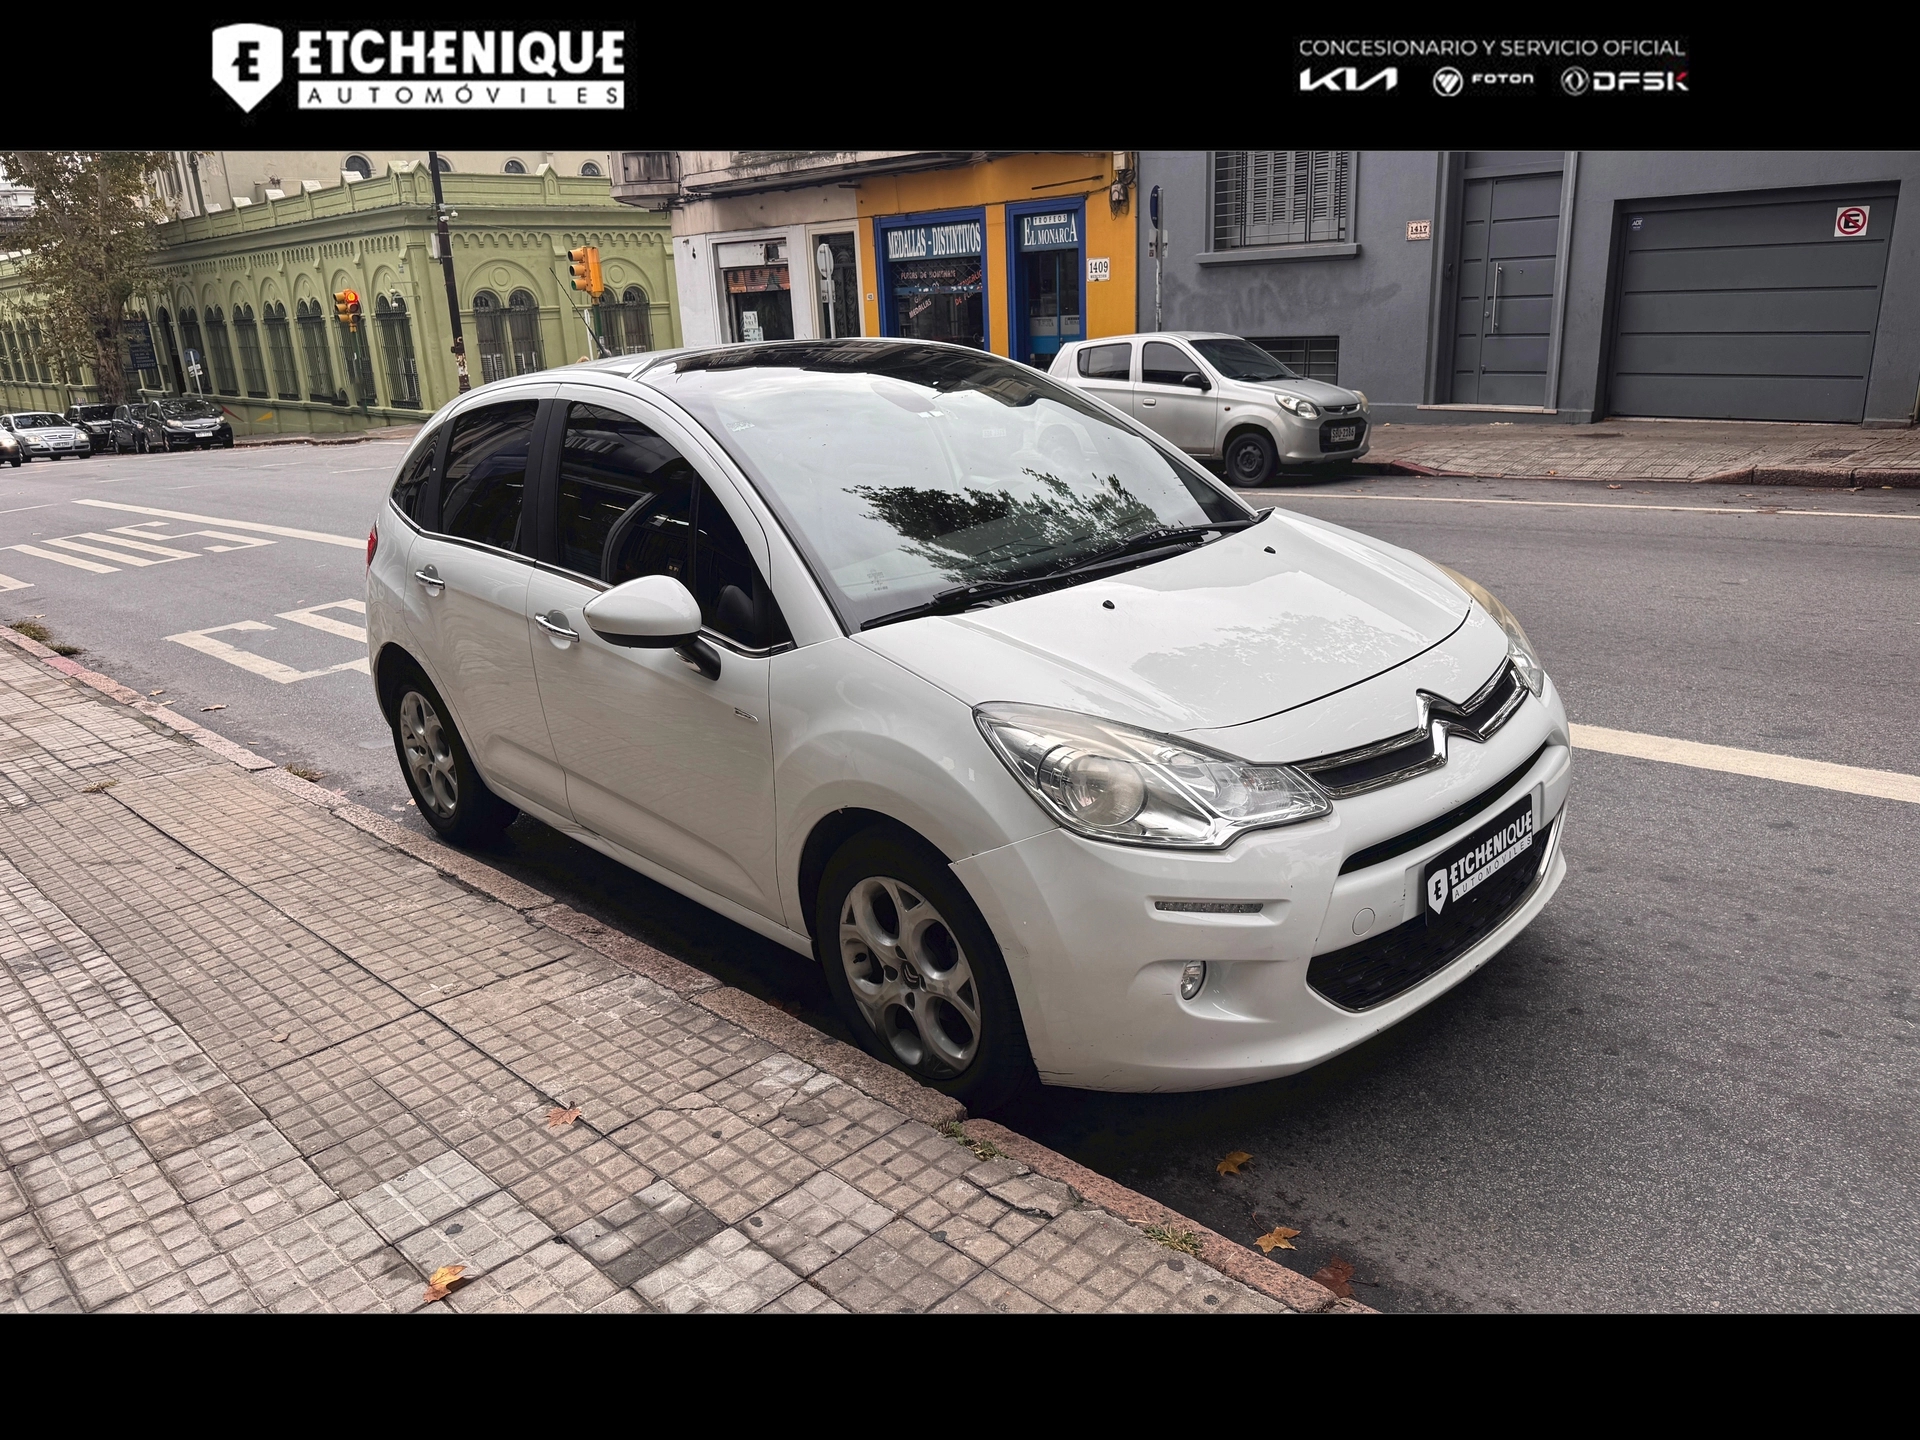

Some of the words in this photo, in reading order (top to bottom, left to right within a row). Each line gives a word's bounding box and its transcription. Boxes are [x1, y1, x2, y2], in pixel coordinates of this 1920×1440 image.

[1033, 213, 1068, 225] TROFEOS
[1038, 212, 1079, 246] MONARCA
[1410, 225, 1428, 233] 1417
[887, 227, 927, 259] MEDALLAS
[931, 222, 982, 256] DISTINTIVOS
[1089, 260, 1109, 274] 1409
[908, 298, 932, 319] MEDALLAS
[1449, 809, 1532, 886] ETCHENIQUE
